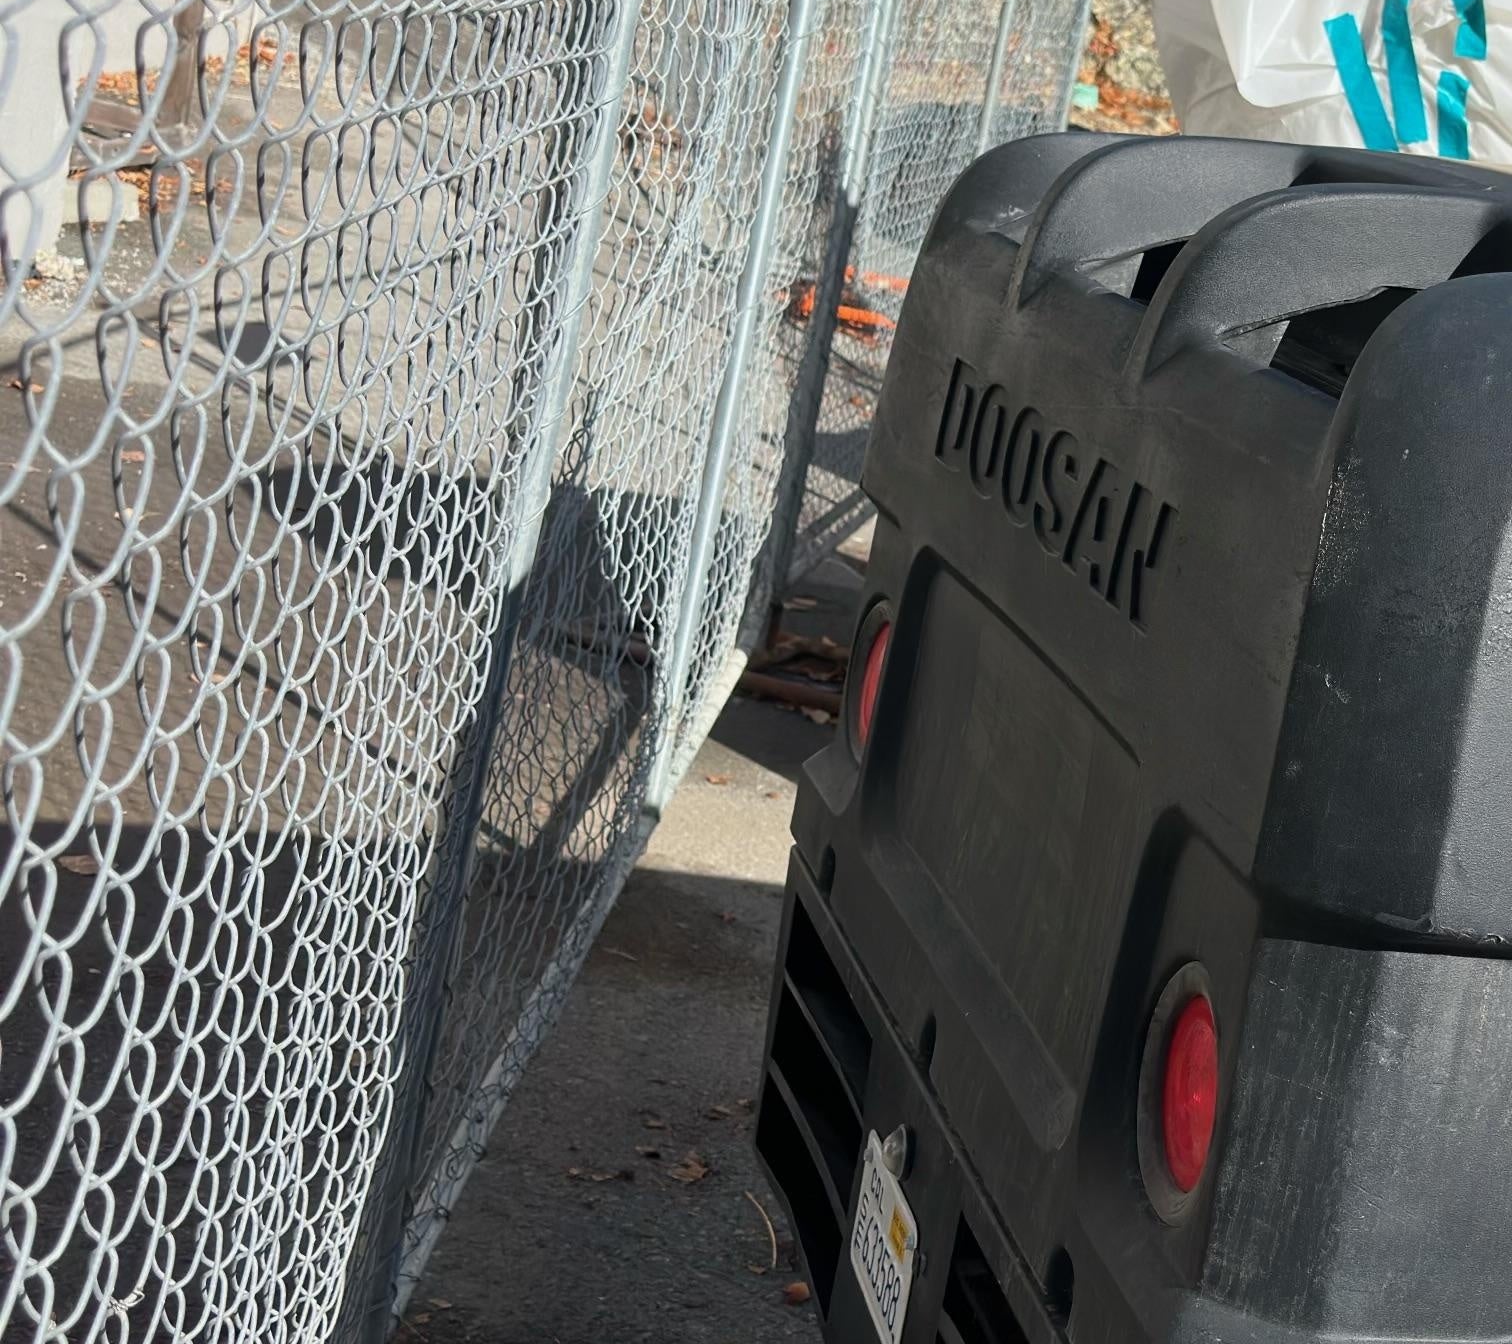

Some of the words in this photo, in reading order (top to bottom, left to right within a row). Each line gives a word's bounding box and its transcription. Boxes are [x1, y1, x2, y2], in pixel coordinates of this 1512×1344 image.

[935, 357, 1180, 636] DOOSAN
[871, 1167, 884, 1215] CAL
[862, 1216, 901, 1331] 633588
